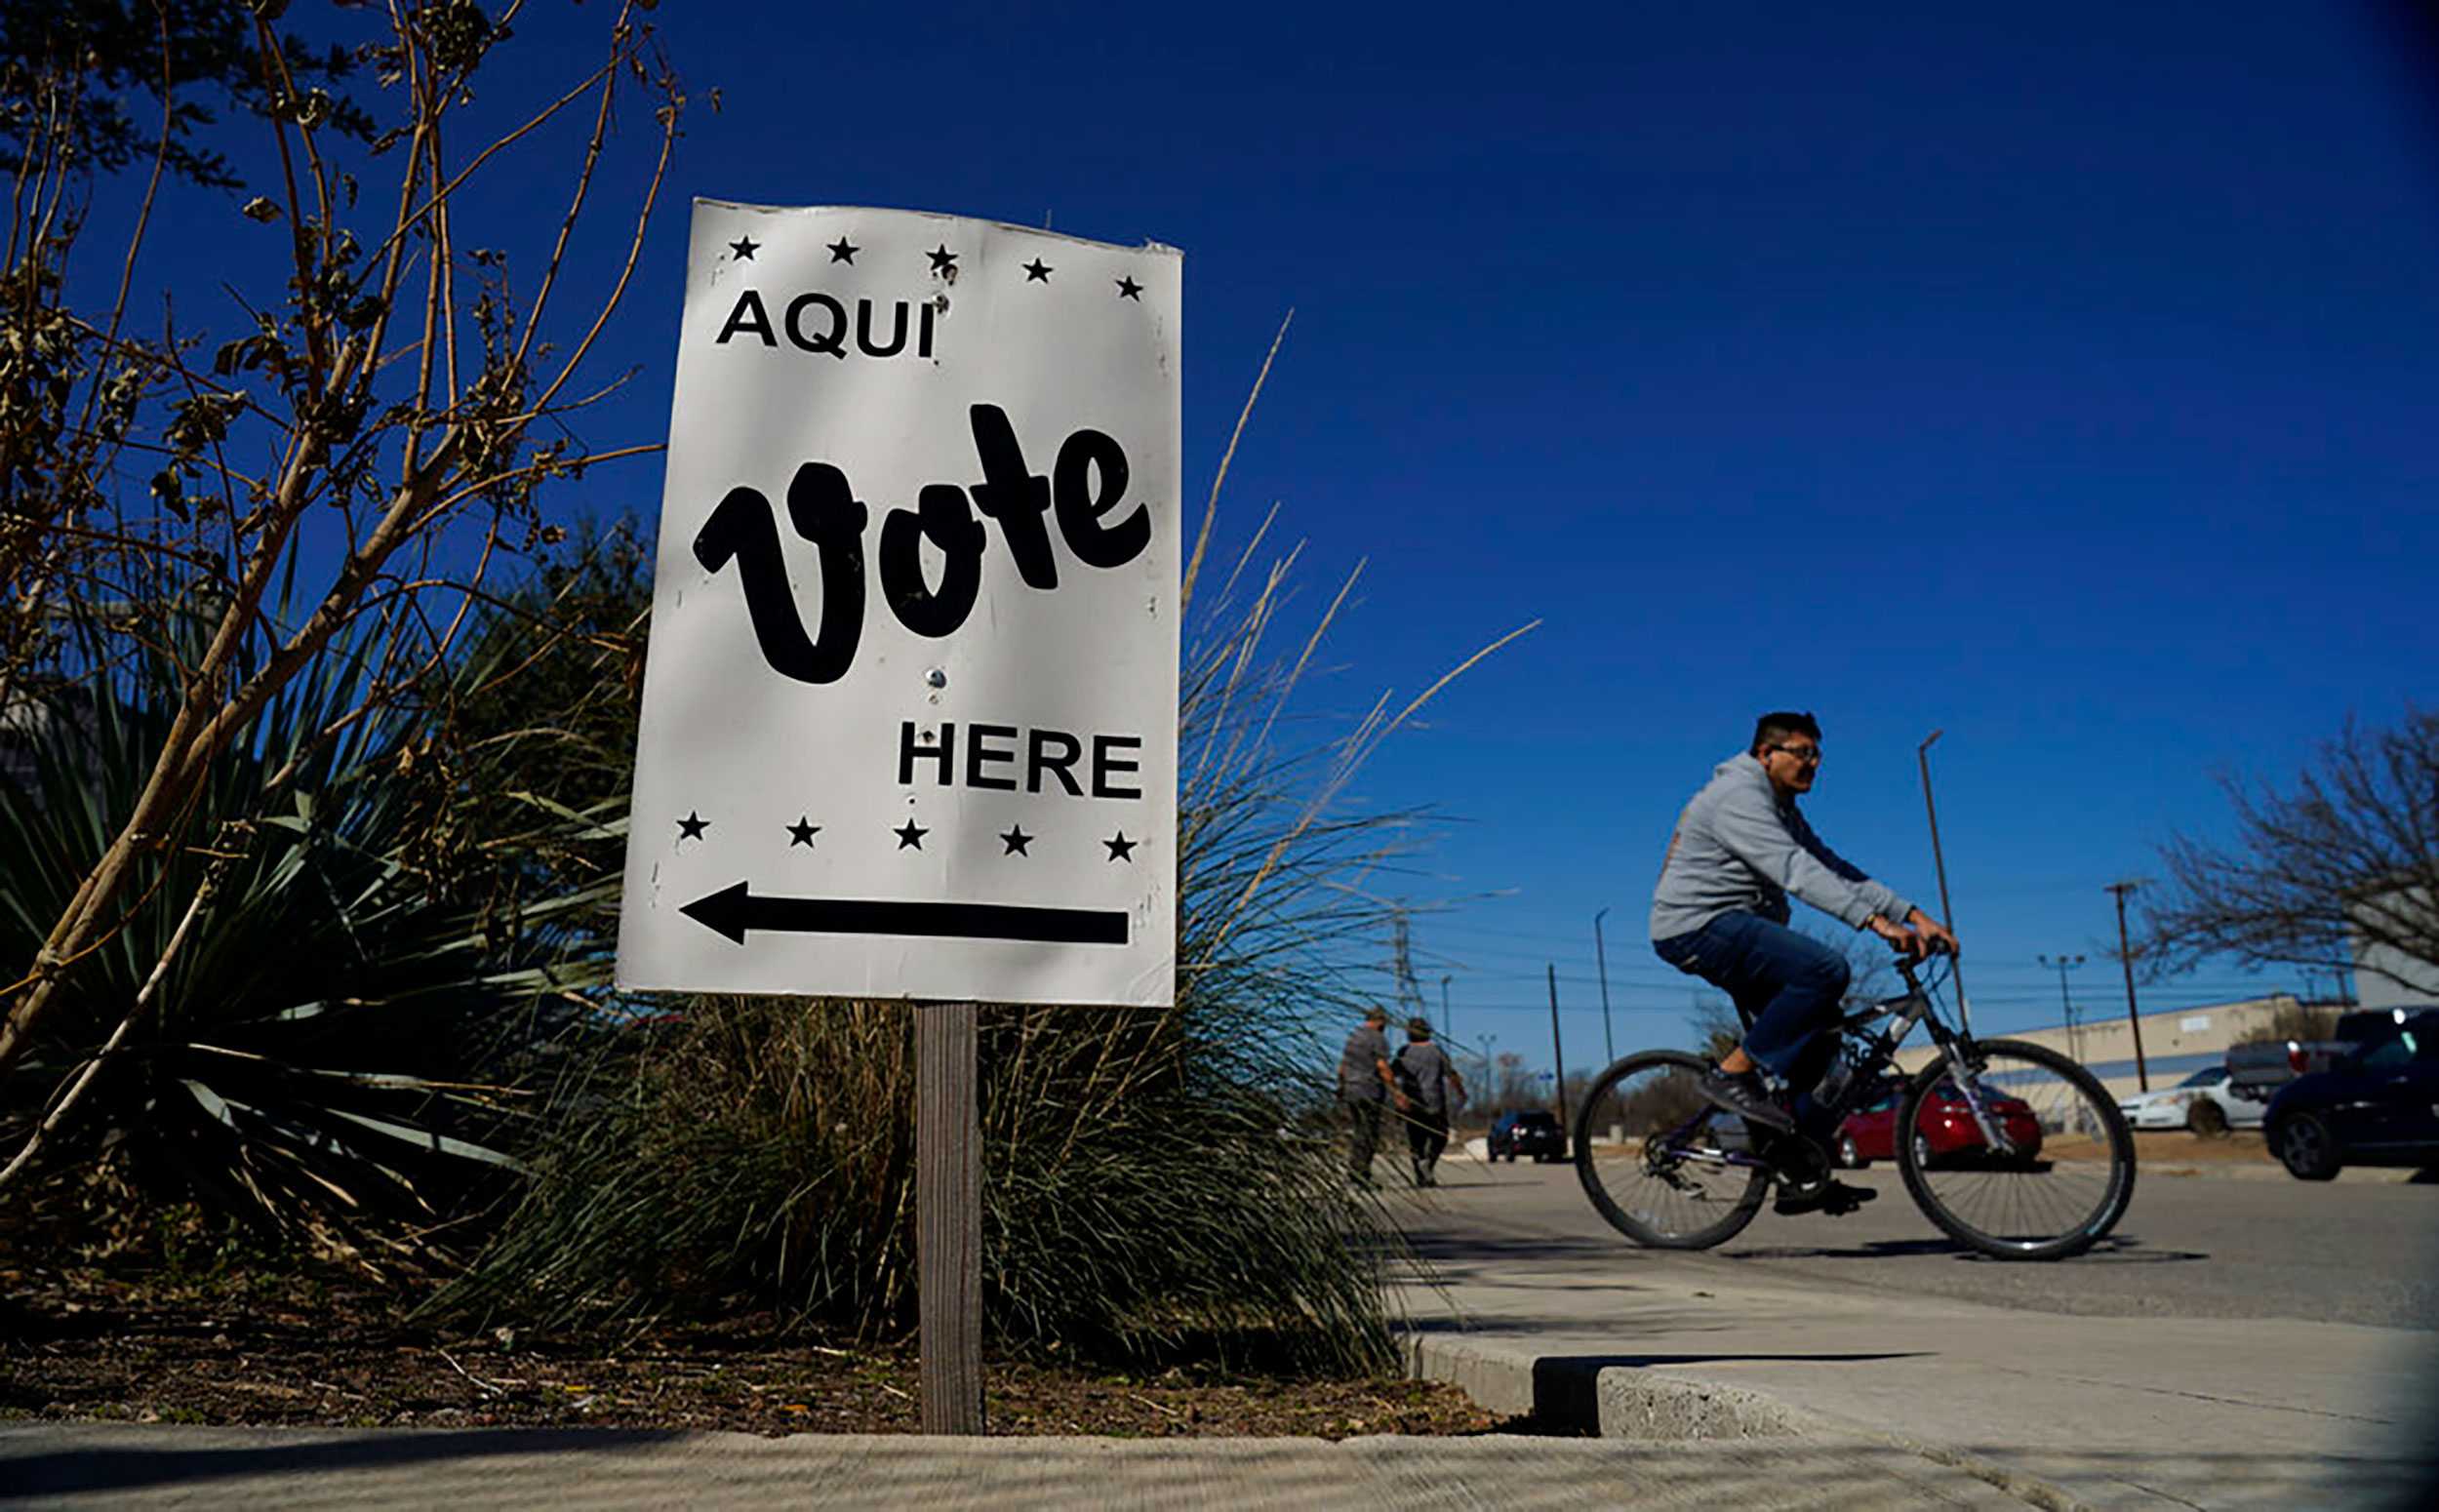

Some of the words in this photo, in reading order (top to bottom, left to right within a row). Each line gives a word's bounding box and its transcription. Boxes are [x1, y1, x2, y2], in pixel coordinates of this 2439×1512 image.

[716, 289, 935, 360] AQUI
[693, 404, 1151, 685] Vote
[899, 722, 1142, 799] HERE
